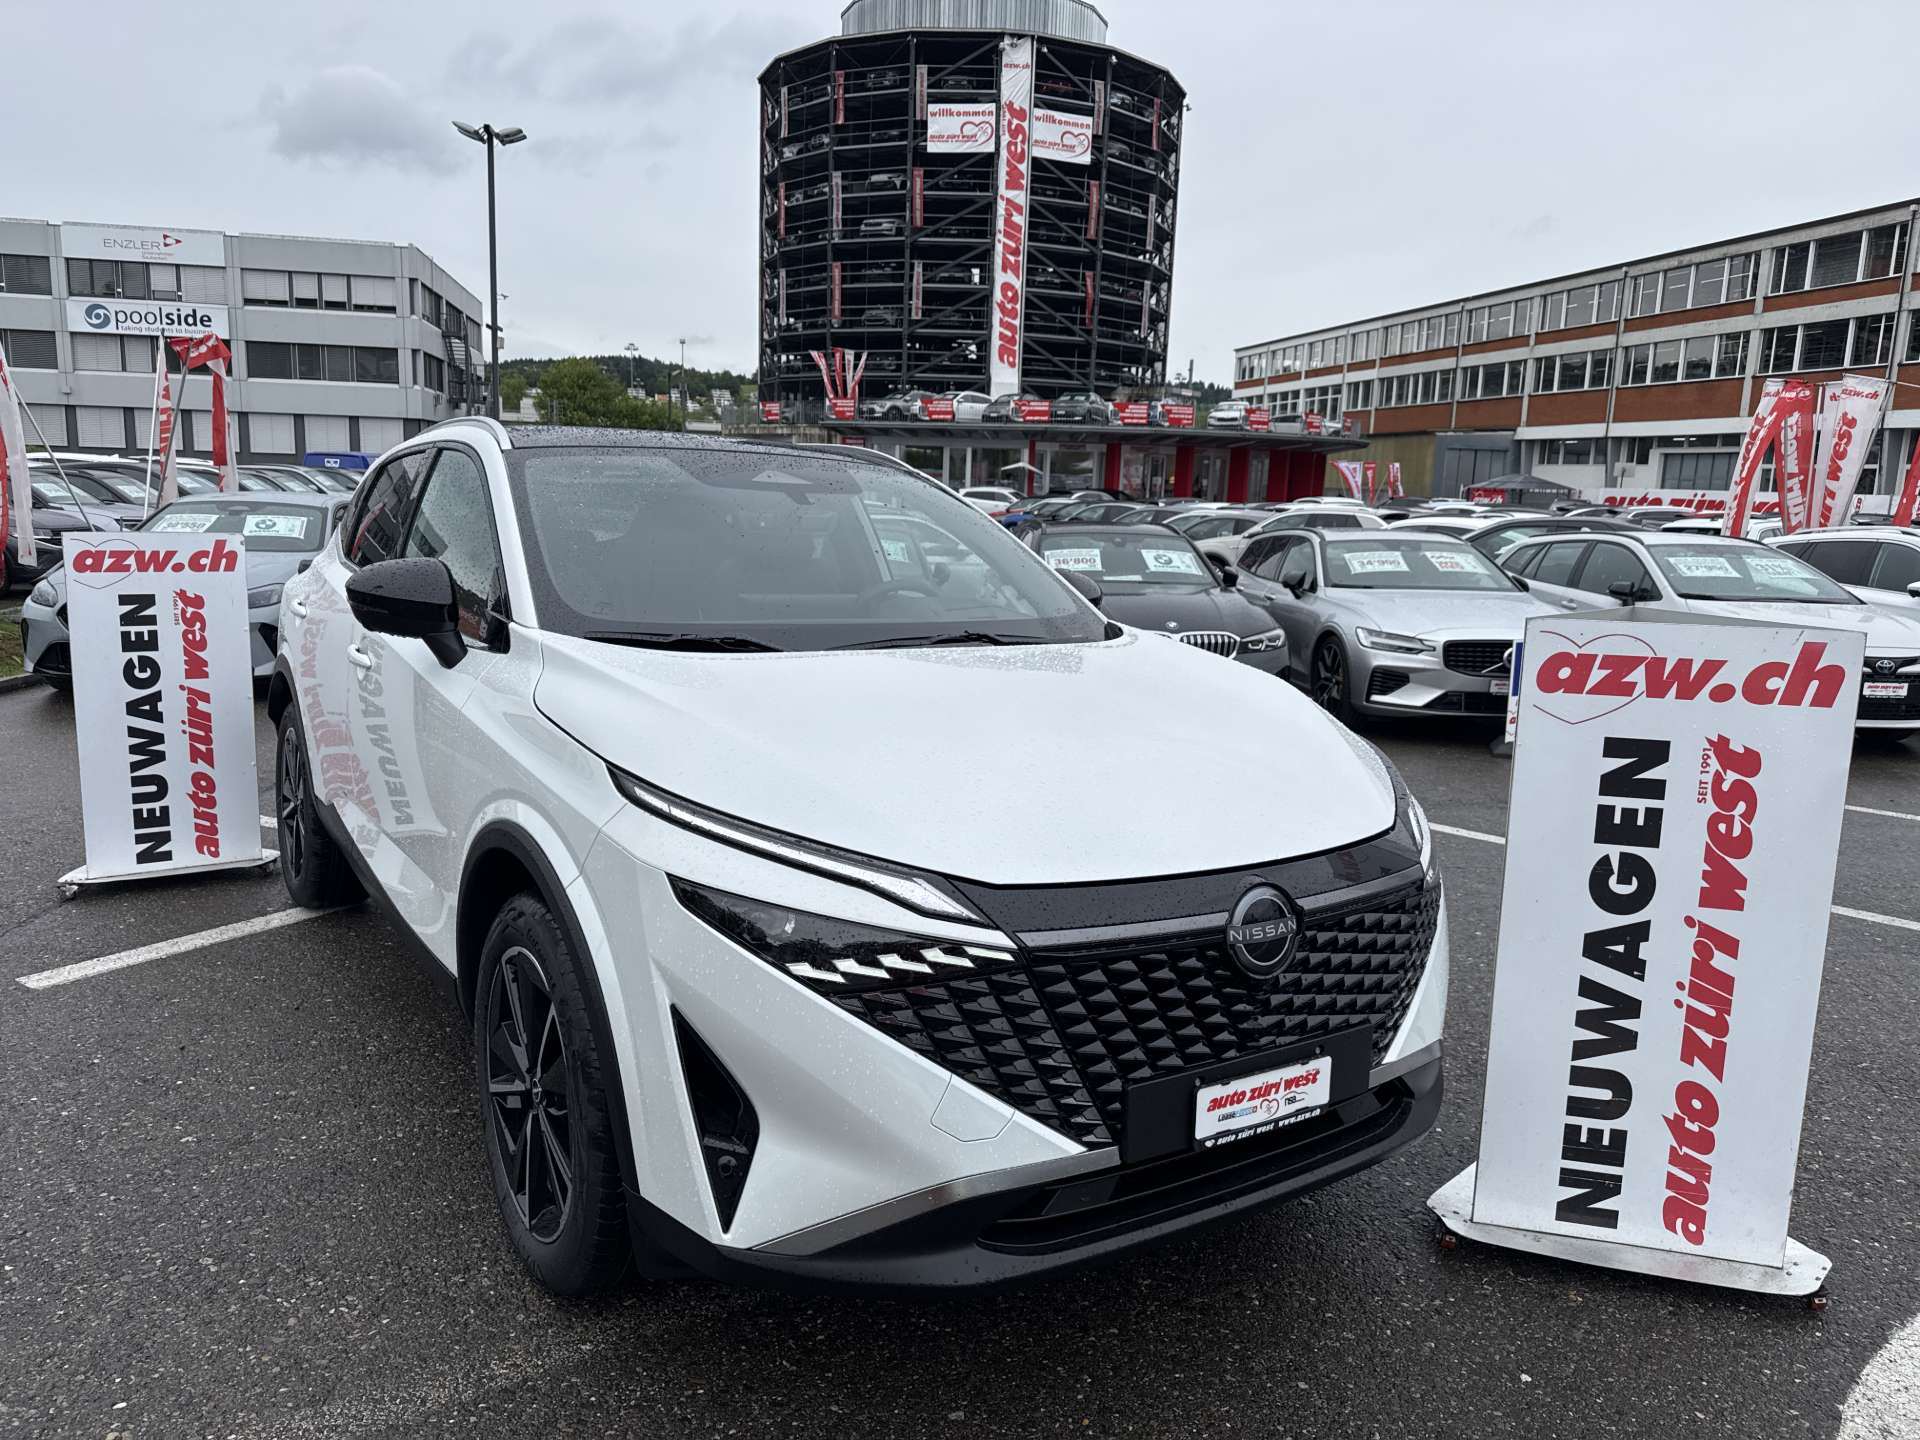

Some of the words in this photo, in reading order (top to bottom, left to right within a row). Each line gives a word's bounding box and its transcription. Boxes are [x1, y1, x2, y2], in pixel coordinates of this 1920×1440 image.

[929, 108, 994, 118] willkommen
[1005, 100, 1028, 191] west
[1034, 114, 1091, 130] willkommen
[103, 238, 161, 250] ENZLER
[997, 194, 1024, 281] züri
[114, 306, 213, 331] poolside
[121, 325, 143, 334] taking
[175, 327, 183, 335] to
[997, 281, 1019, 369] auto
[1841, 387, 1879, 400] azw.ch
[1826, 410, 1858, 482] west
[72, 539, 239, 574] azw.ch
[173, 588, 210, 681] west
[1535, 641, 1847, 709] azw.ch
[117, 593, 173, 865] NEUWAGEN
[178, 684, 215, 769] züri
[1701, 747, 1713, 771] 1991
[186, 771, 221, 859] auto
[1697, 772, 1709, 804] SEIT
[1697, 733, 1764, 912] west
[1229, 919, 1297, 942] NISSAN
[1555, 736, 1672, 1231] NEUWAGEN
[1674, 914, 1743, 1083] züri
[1206, 1088, 1247, 1112] auto
[1247, 1078, 1283, 1102] züri
[1283, 1068, 1320, 1092] west
[1216, 1134, 1236, 1145] auto
[1237, 1127, 1256, 1140] züri
[1256, 1122, 1275, 1134] west
[1661, 1079, 1721, 1247] auto
